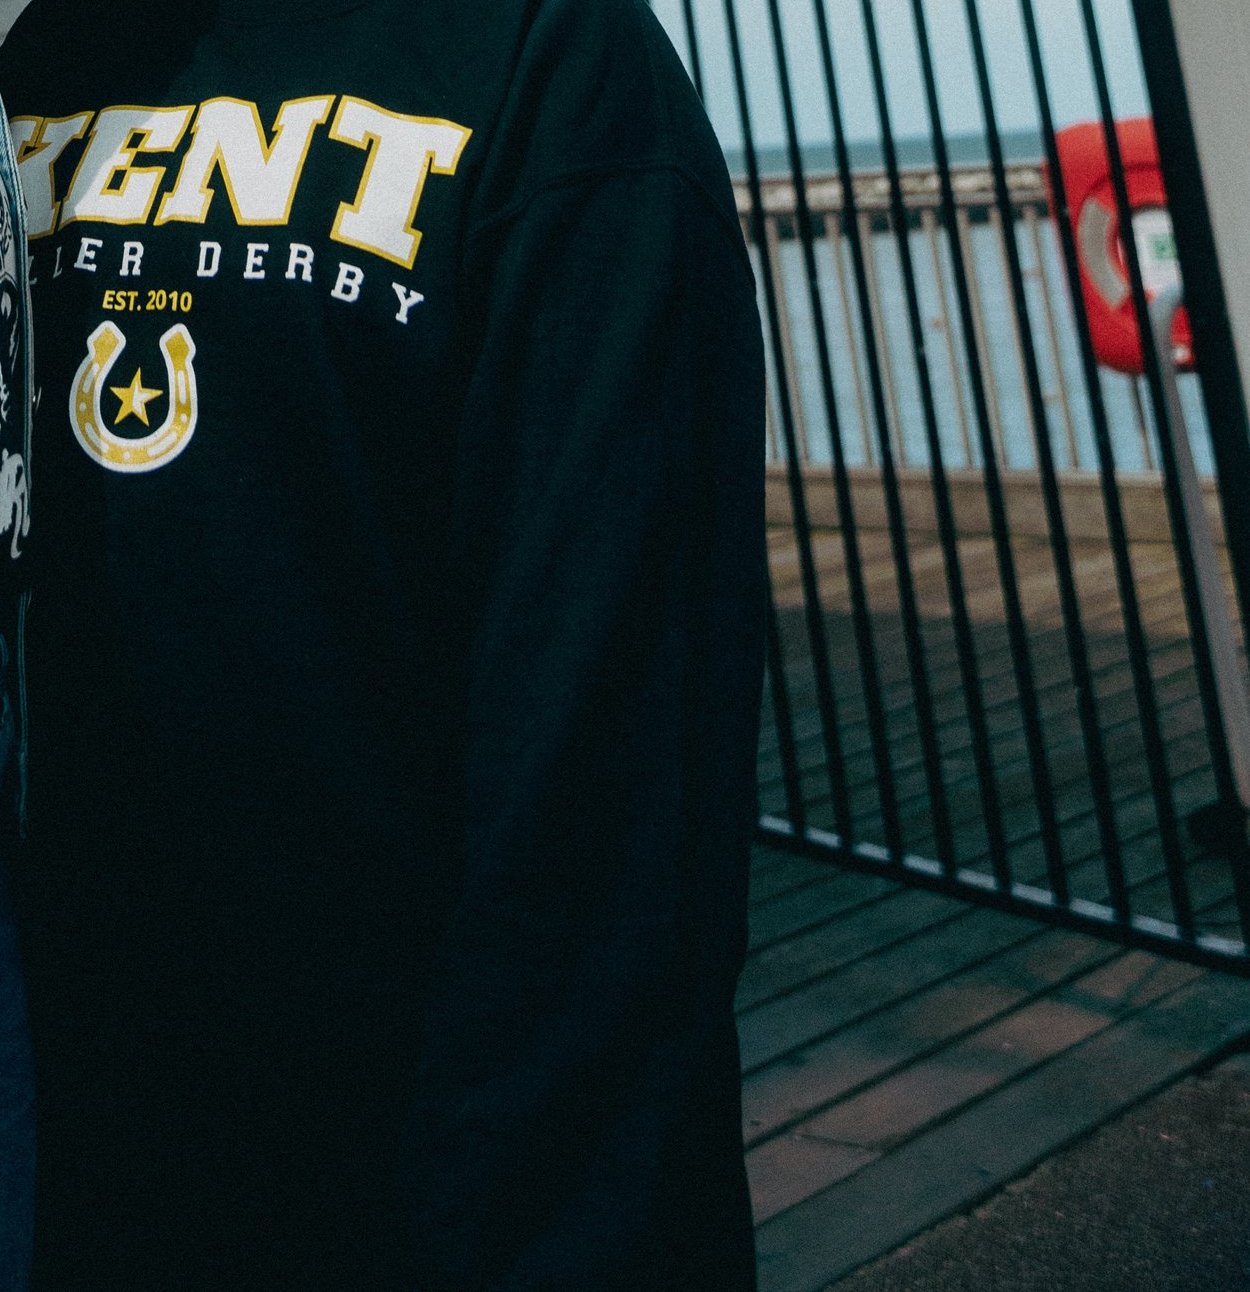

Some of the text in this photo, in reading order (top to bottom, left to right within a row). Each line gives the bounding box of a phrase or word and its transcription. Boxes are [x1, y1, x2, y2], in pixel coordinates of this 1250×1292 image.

[101, 288, 193, 313] EST. 2010
[196, 240, 425, 325] DERBY
